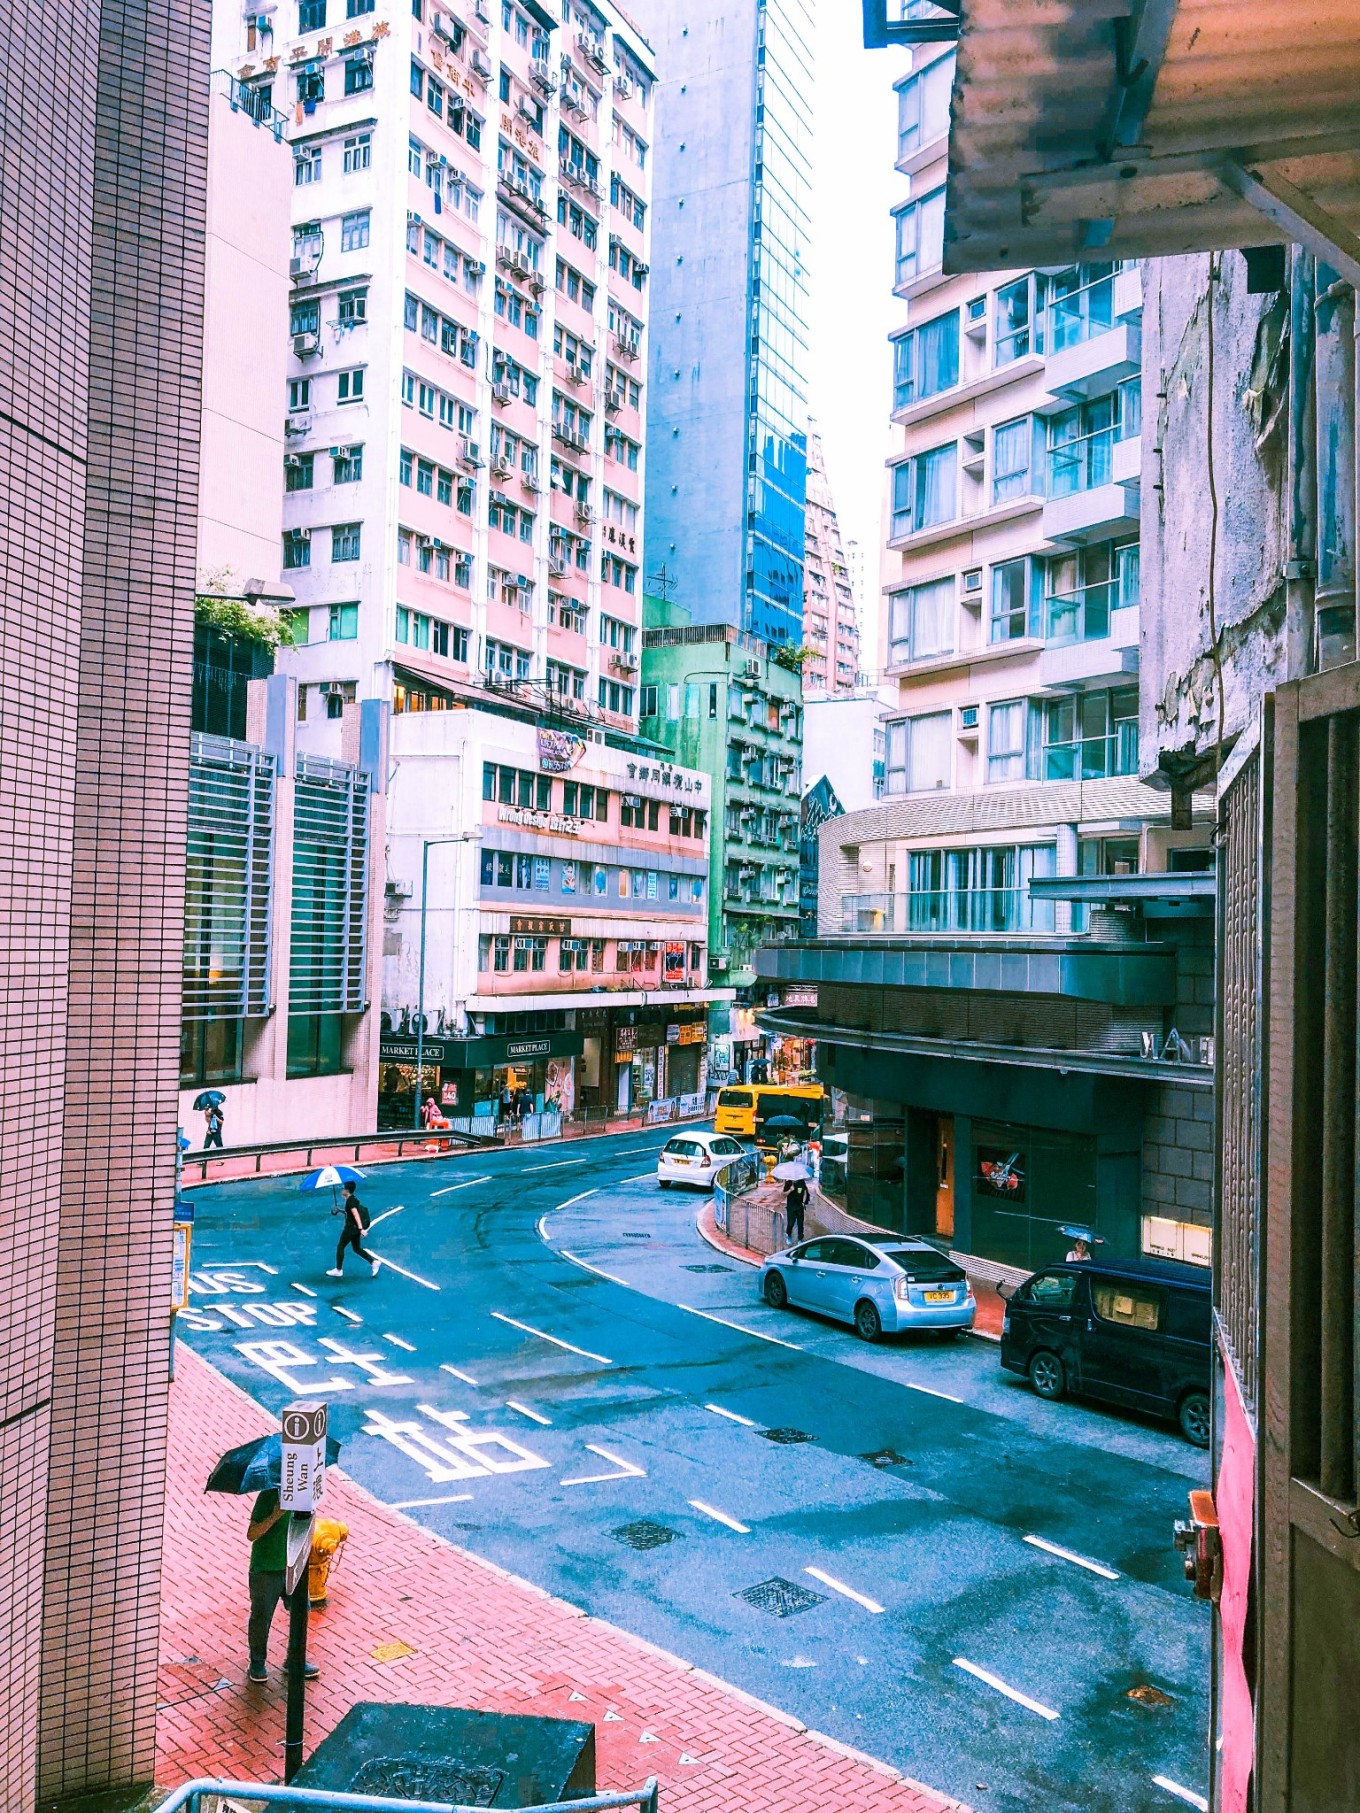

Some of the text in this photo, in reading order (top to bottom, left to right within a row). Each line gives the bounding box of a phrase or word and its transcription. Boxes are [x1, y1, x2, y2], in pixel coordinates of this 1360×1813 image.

[381, 1046, 414, 1055] MARKET
[510, 1042, 548, 1054] MARKET PLACE
[187, 1272, 266, 1294] US
[176, 1302, 318, 1332] STOP
[360, 1402, 553, 1483] 站
[283, 1453, 298, 1502] Sheung
[297, 1463, 308, 1493] Wan
[312, 1447, 324, 1502] 上環
